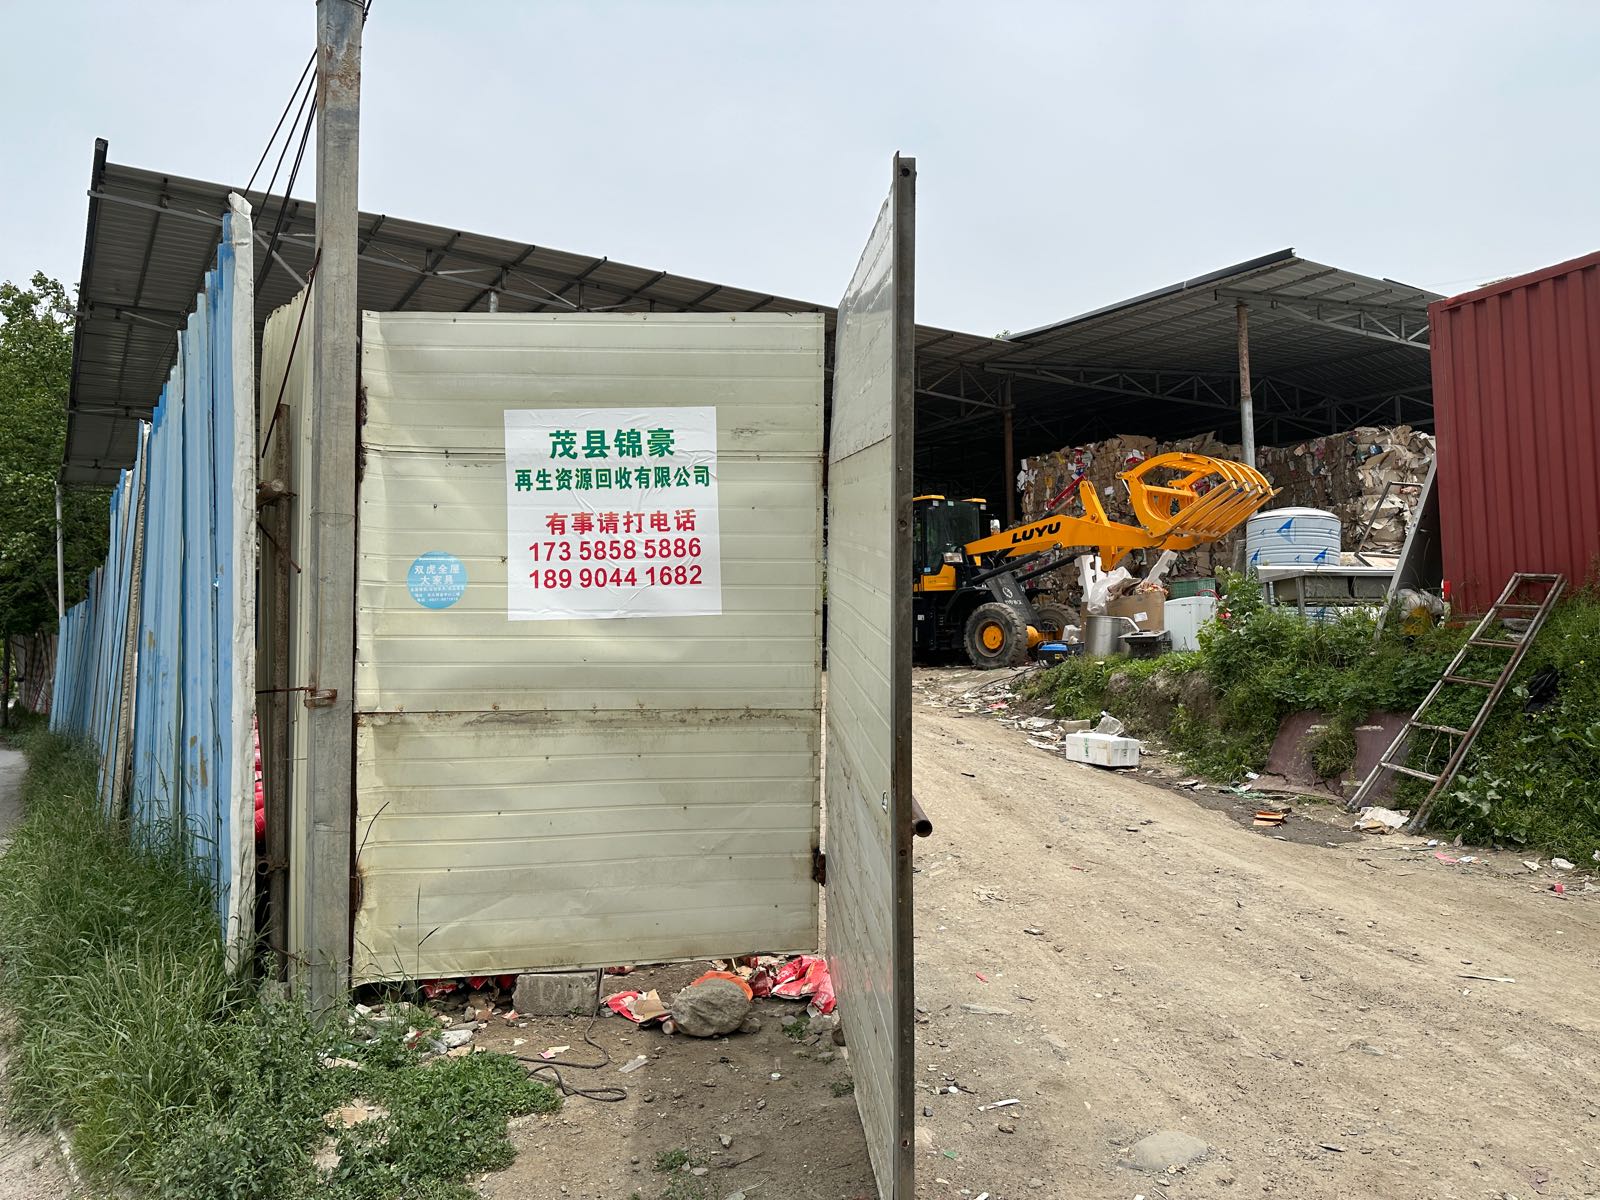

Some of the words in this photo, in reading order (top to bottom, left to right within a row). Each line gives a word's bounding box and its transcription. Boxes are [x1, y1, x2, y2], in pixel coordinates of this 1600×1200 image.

[548, 427, 676, 460] 茂县锦豪
[514, 465, 711, 492] 再生资源回收有限公司
[545, 508, 697, 536] 有事请打电话
[1011, 521, 1061, 544] LUYU
[528, 541, 572, 562] 173
[578, 539, 637, 561] 5858
[643, 537, 702, 559] 5886
[529, 568, 572, 589] 189
[579, 566, 638, 589] 9044
[645, 564, 703, 587] 1682
